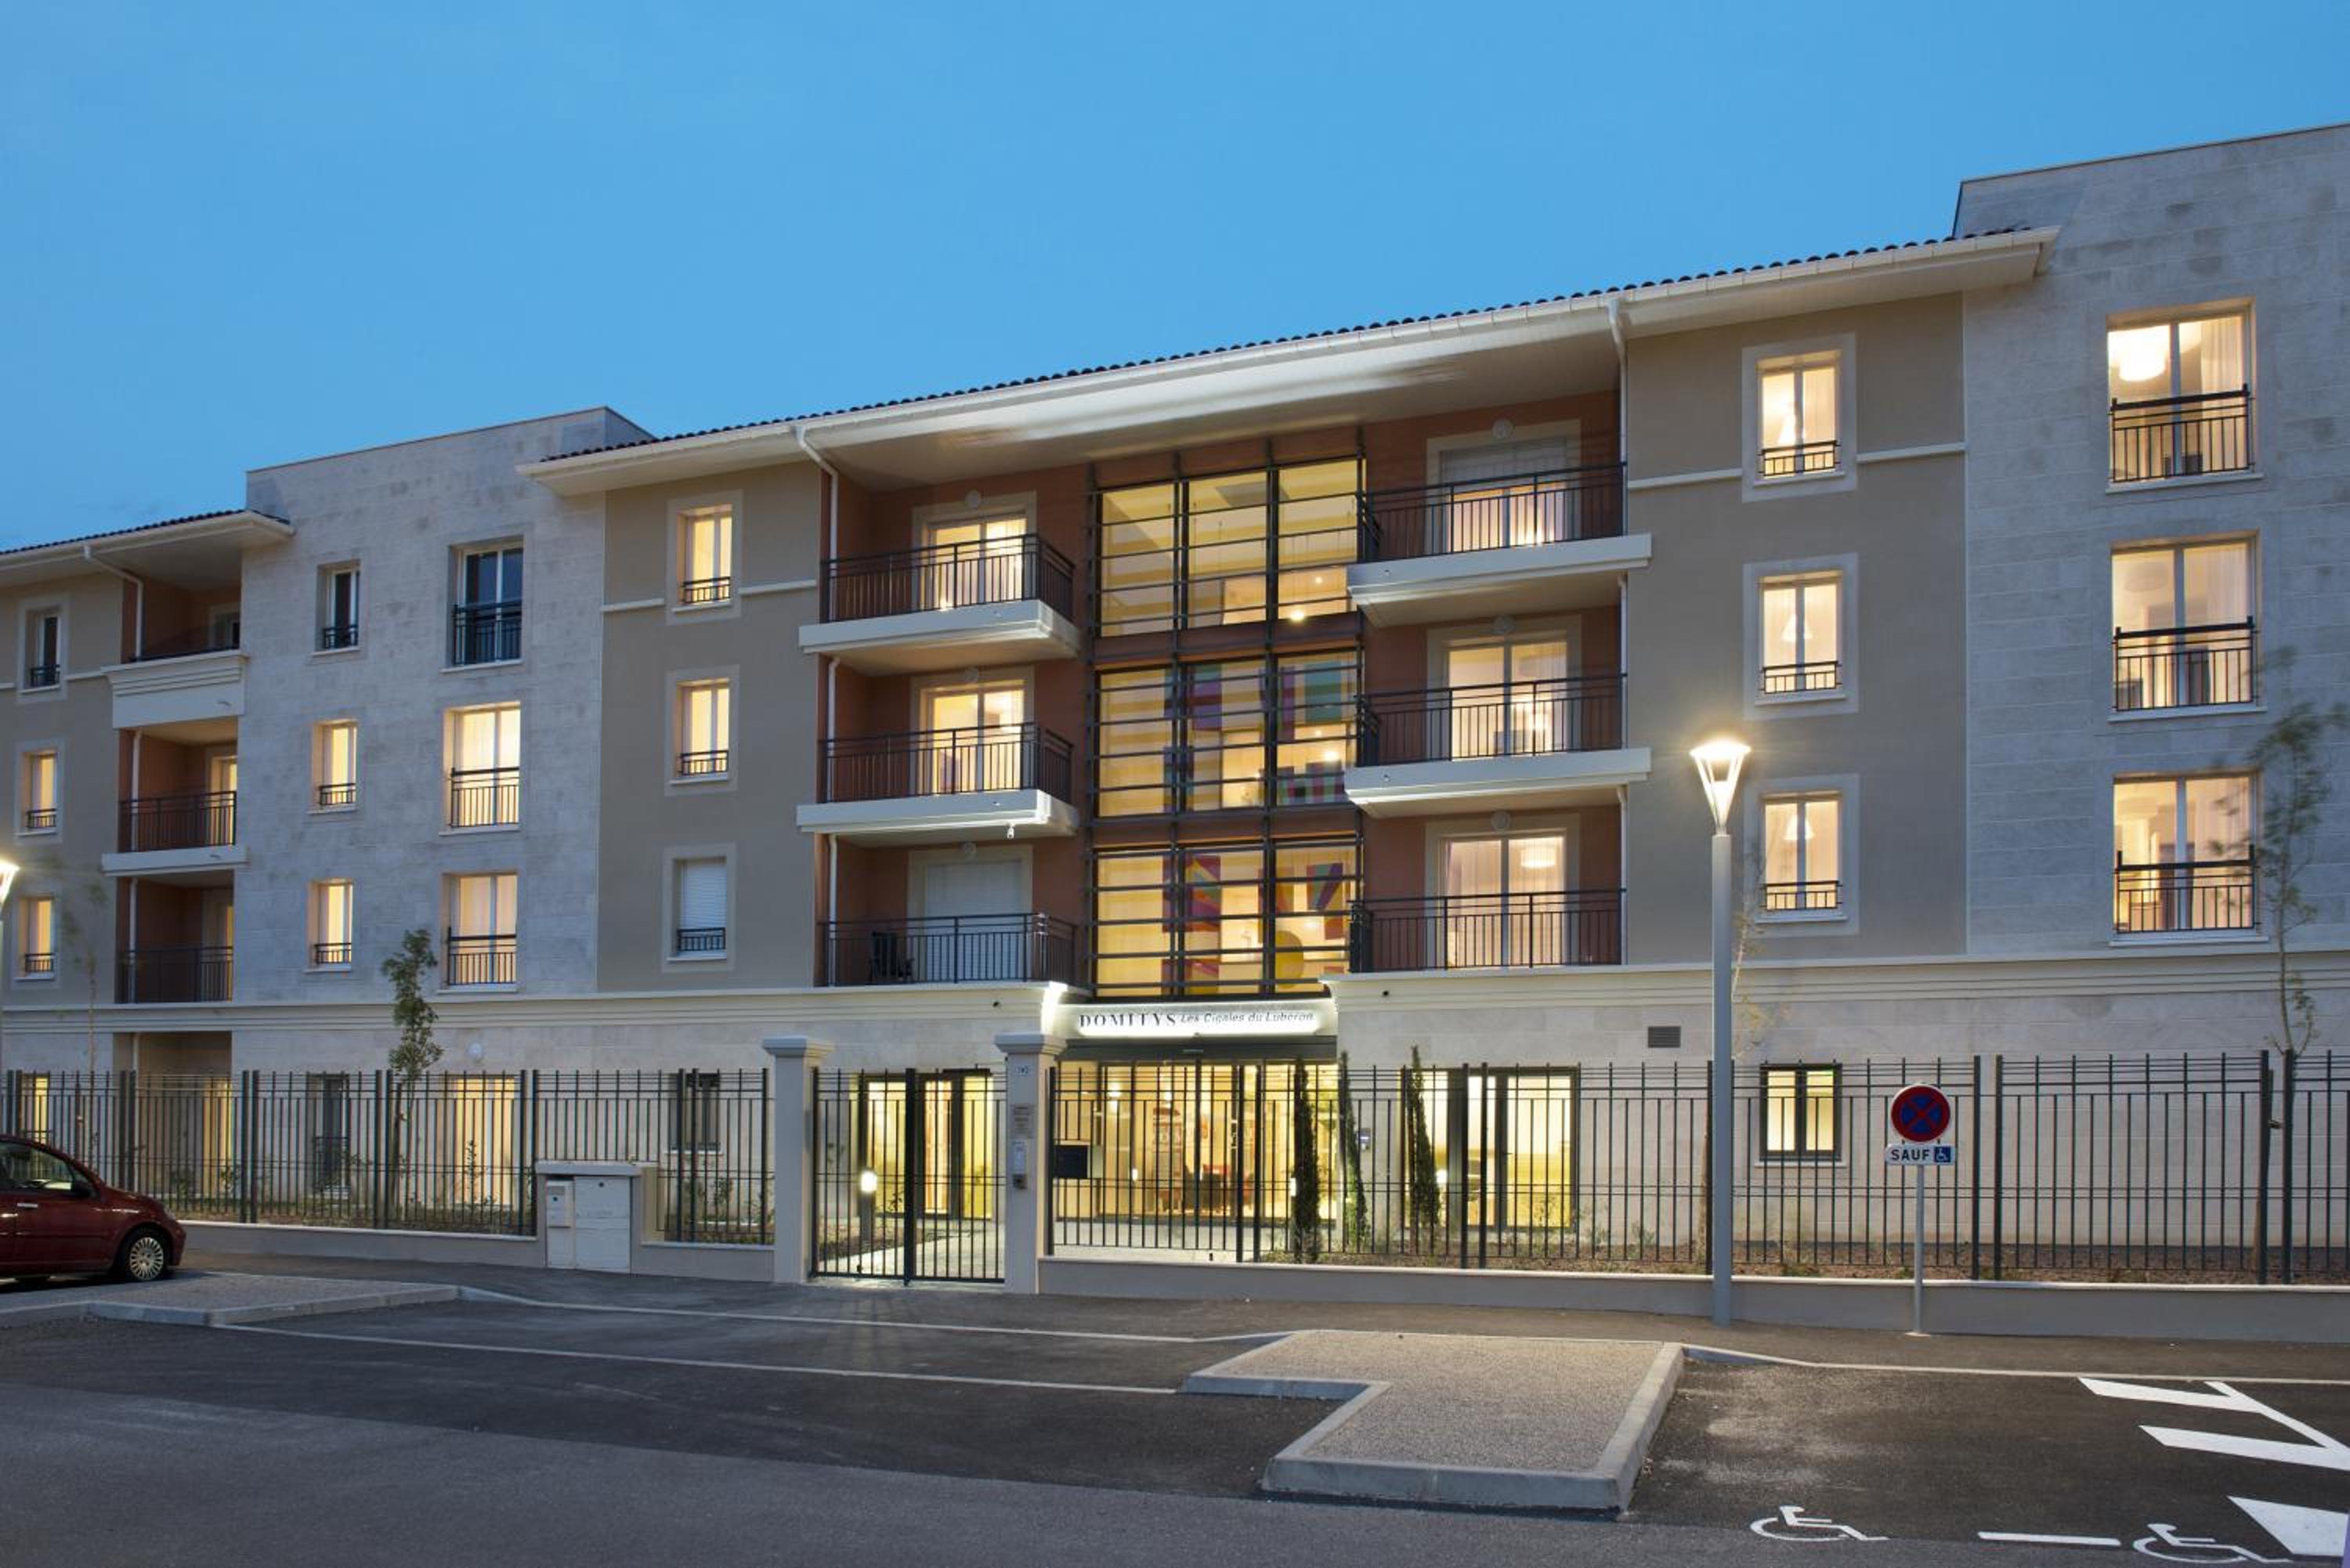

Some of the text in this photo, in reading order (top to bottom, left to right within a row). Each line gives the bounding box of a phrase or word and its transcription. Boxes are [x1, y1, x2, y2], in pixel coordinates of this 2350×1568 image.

[1079, 1013, 1175, 1027] DOMITYS
[1180, 1013, 1199, 1023] Les
[1204, 1013, 1245, 1024] Cigales
[1248, 1012, 1262, 1023] du
[1891, 1148, 1930, 1161] SAUF
